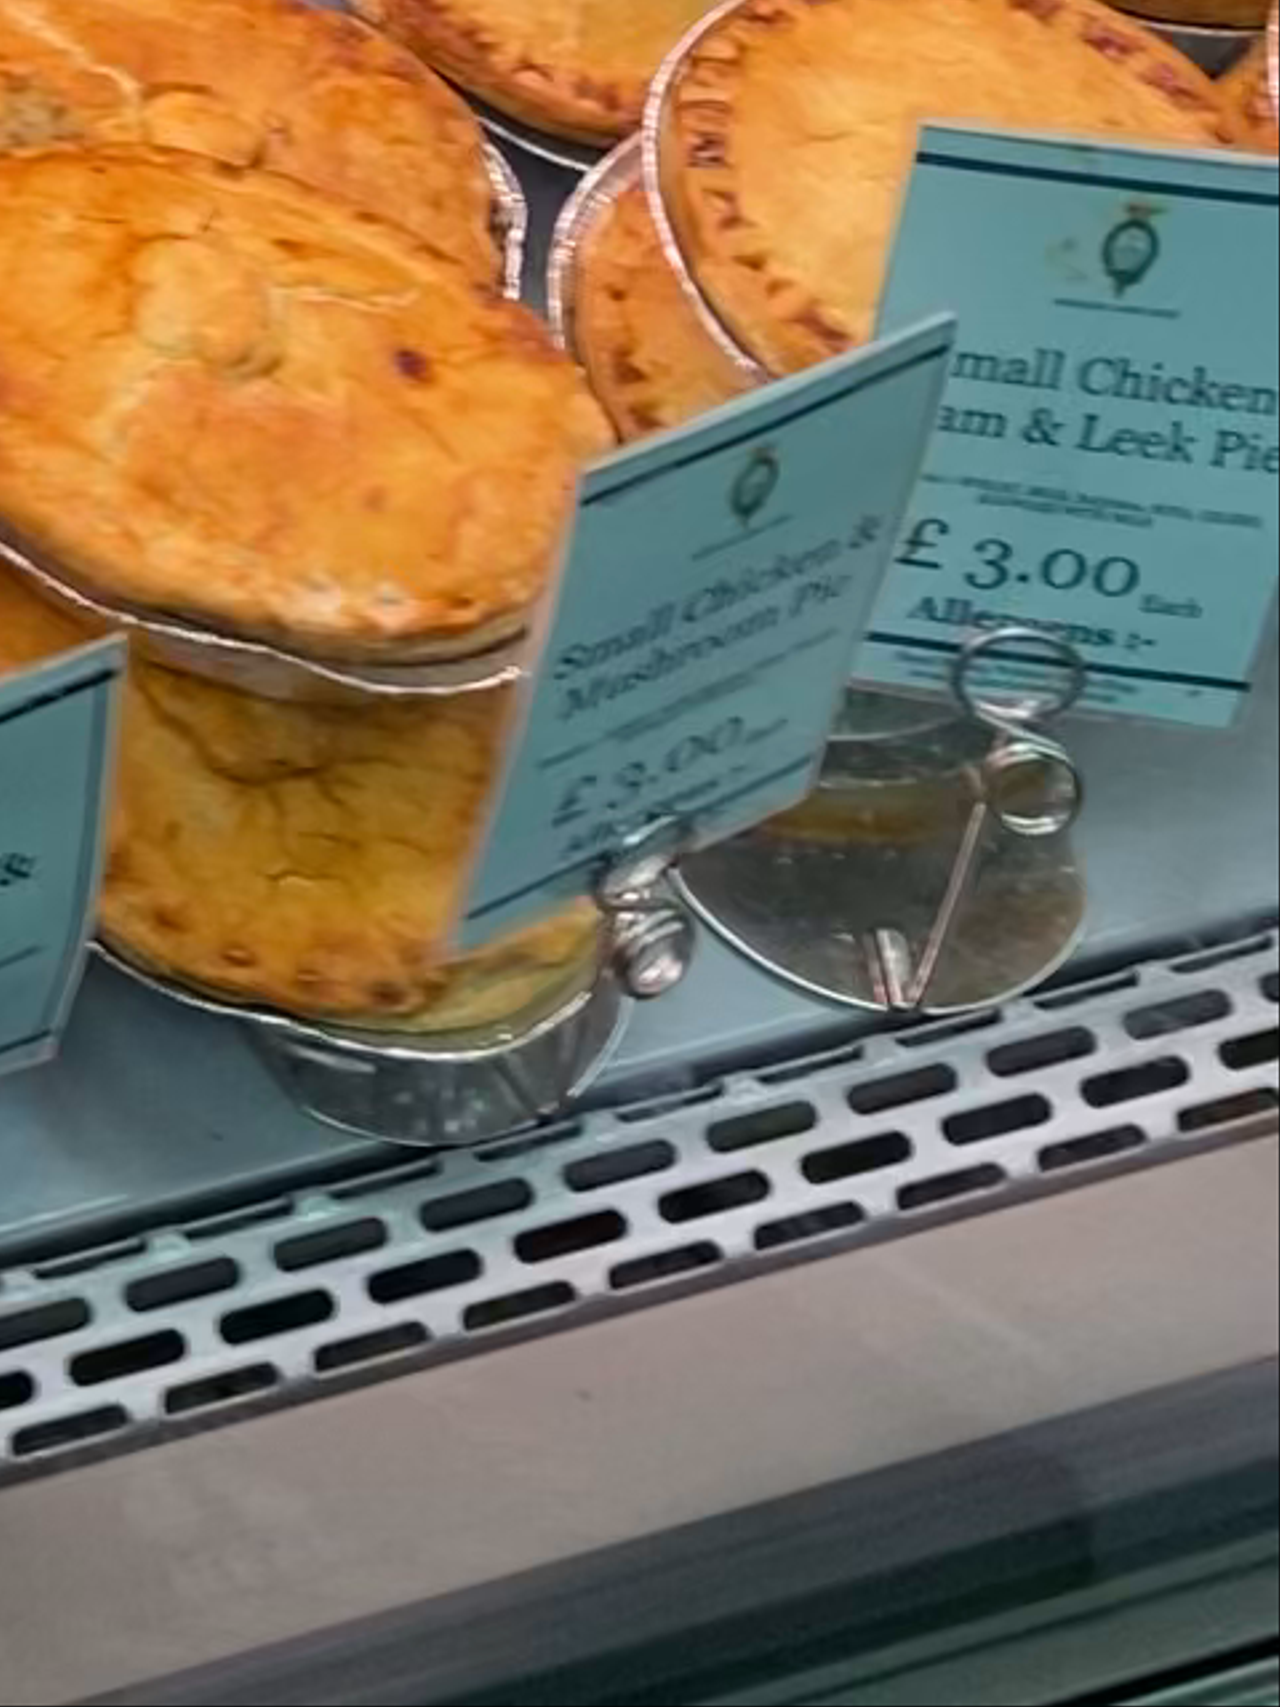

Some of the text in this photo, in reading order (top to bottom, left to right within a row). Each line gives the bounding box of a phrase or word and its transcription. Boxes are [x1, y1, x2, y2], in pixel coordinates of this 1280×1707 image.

[950, 346, 1277, 416] mall Chicken
[938, 403, 1279, 475] am & Leek Pie
[552, 513, 883, 681] Small Chicken &
[560, 604, 780, 721] Mushroom
[787, 573, 854, 619] Pie
